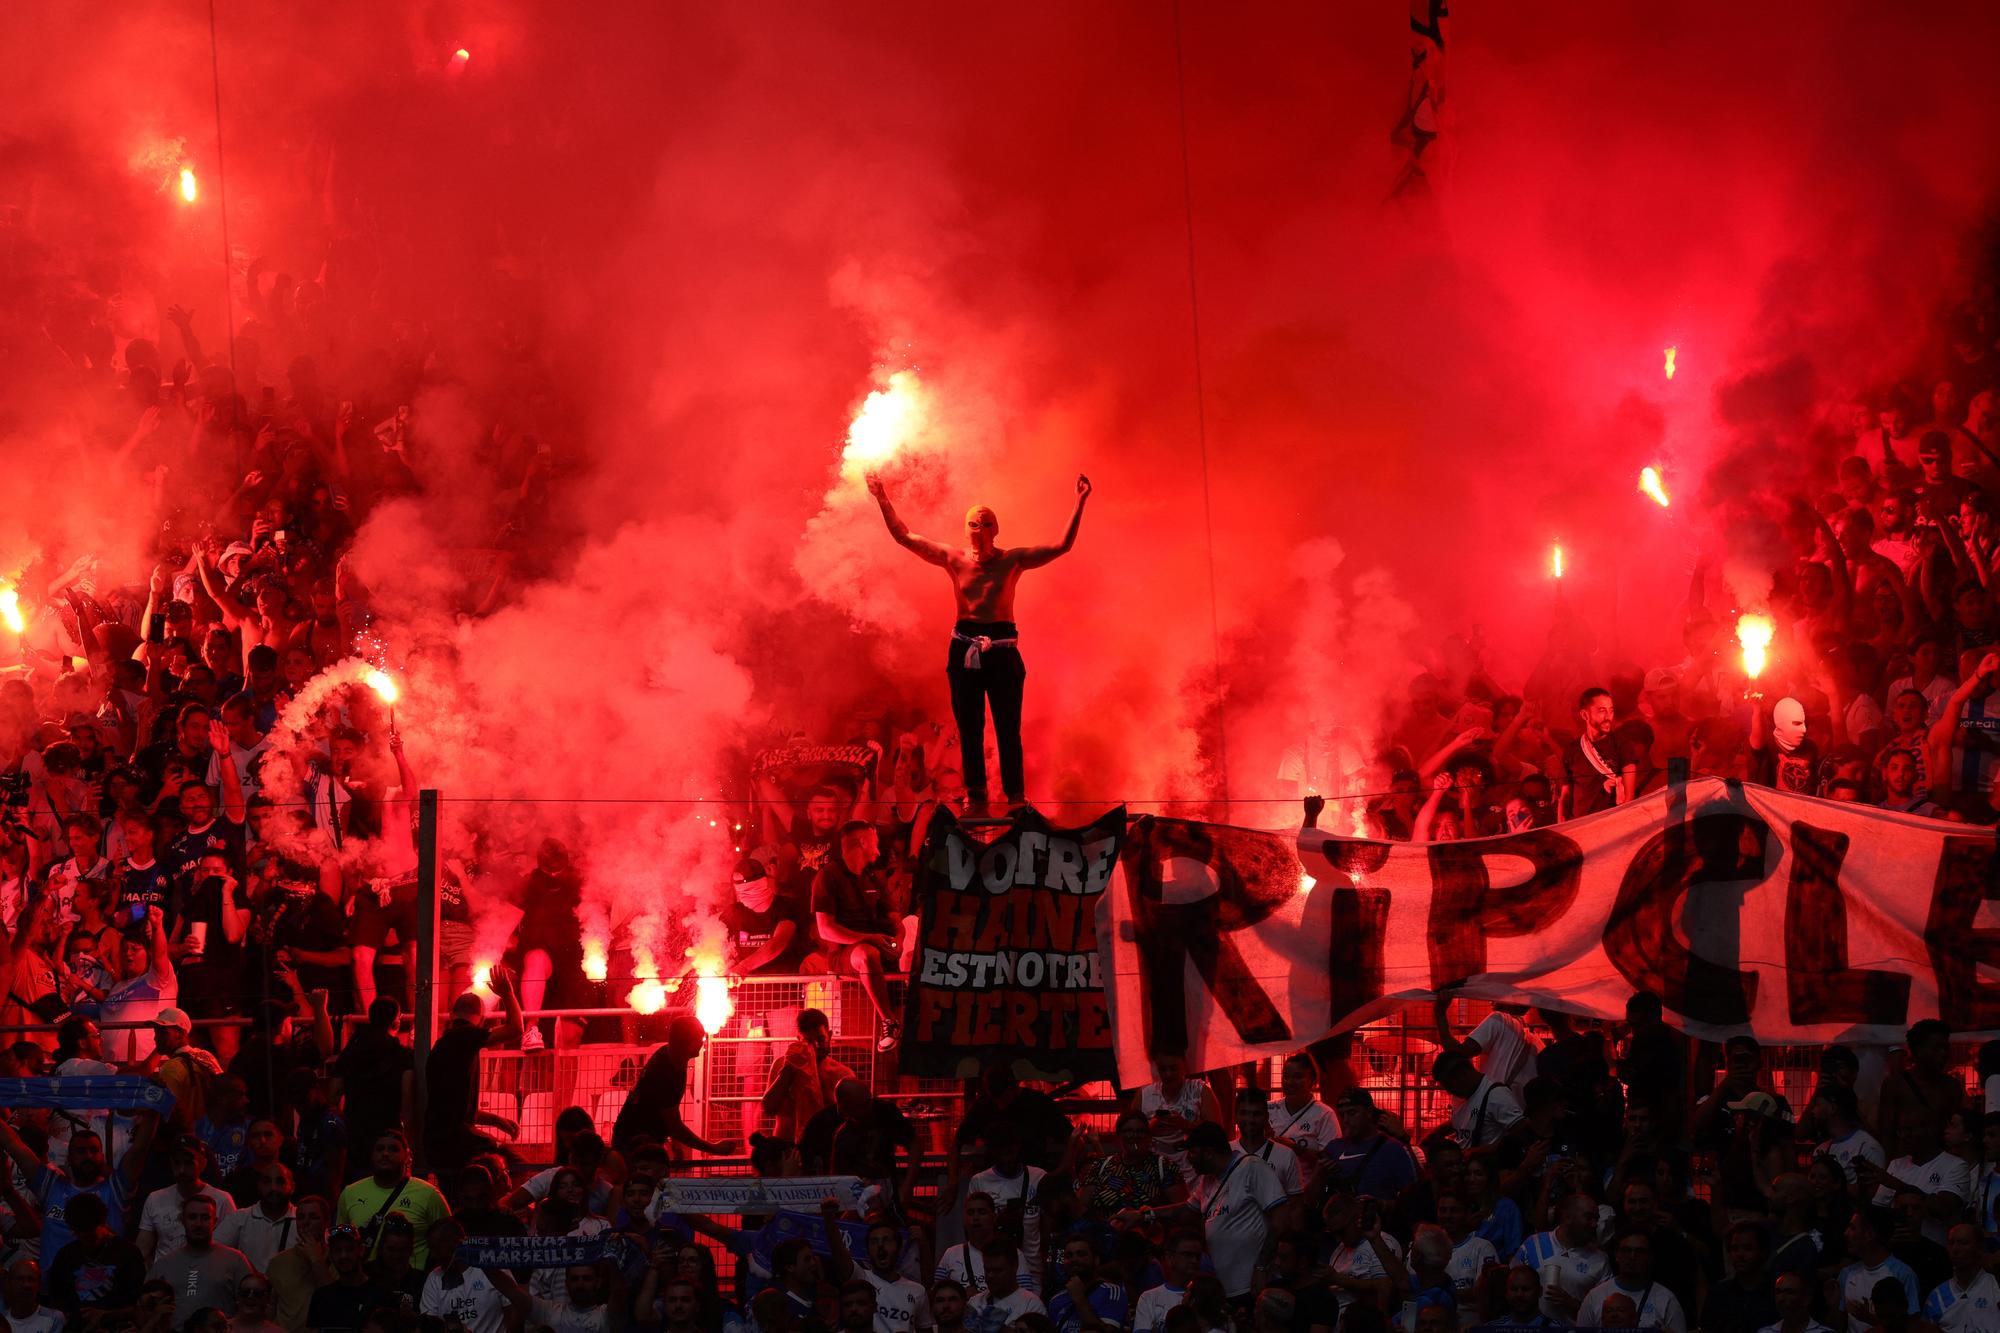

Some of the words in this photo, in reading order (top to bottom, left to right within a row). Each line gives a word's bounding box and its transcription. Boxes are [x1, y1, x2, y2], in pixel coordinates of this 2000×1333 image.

[944, 831, 1116, 895] VOTRE
[916, 988, 1113, 1050] FIERTE
[499, 1236, 567, 1248] ULTRAS
[479, 1248, 585, 1264] MARSEILLE
[187, 1270, 200, 1296] NIKE
